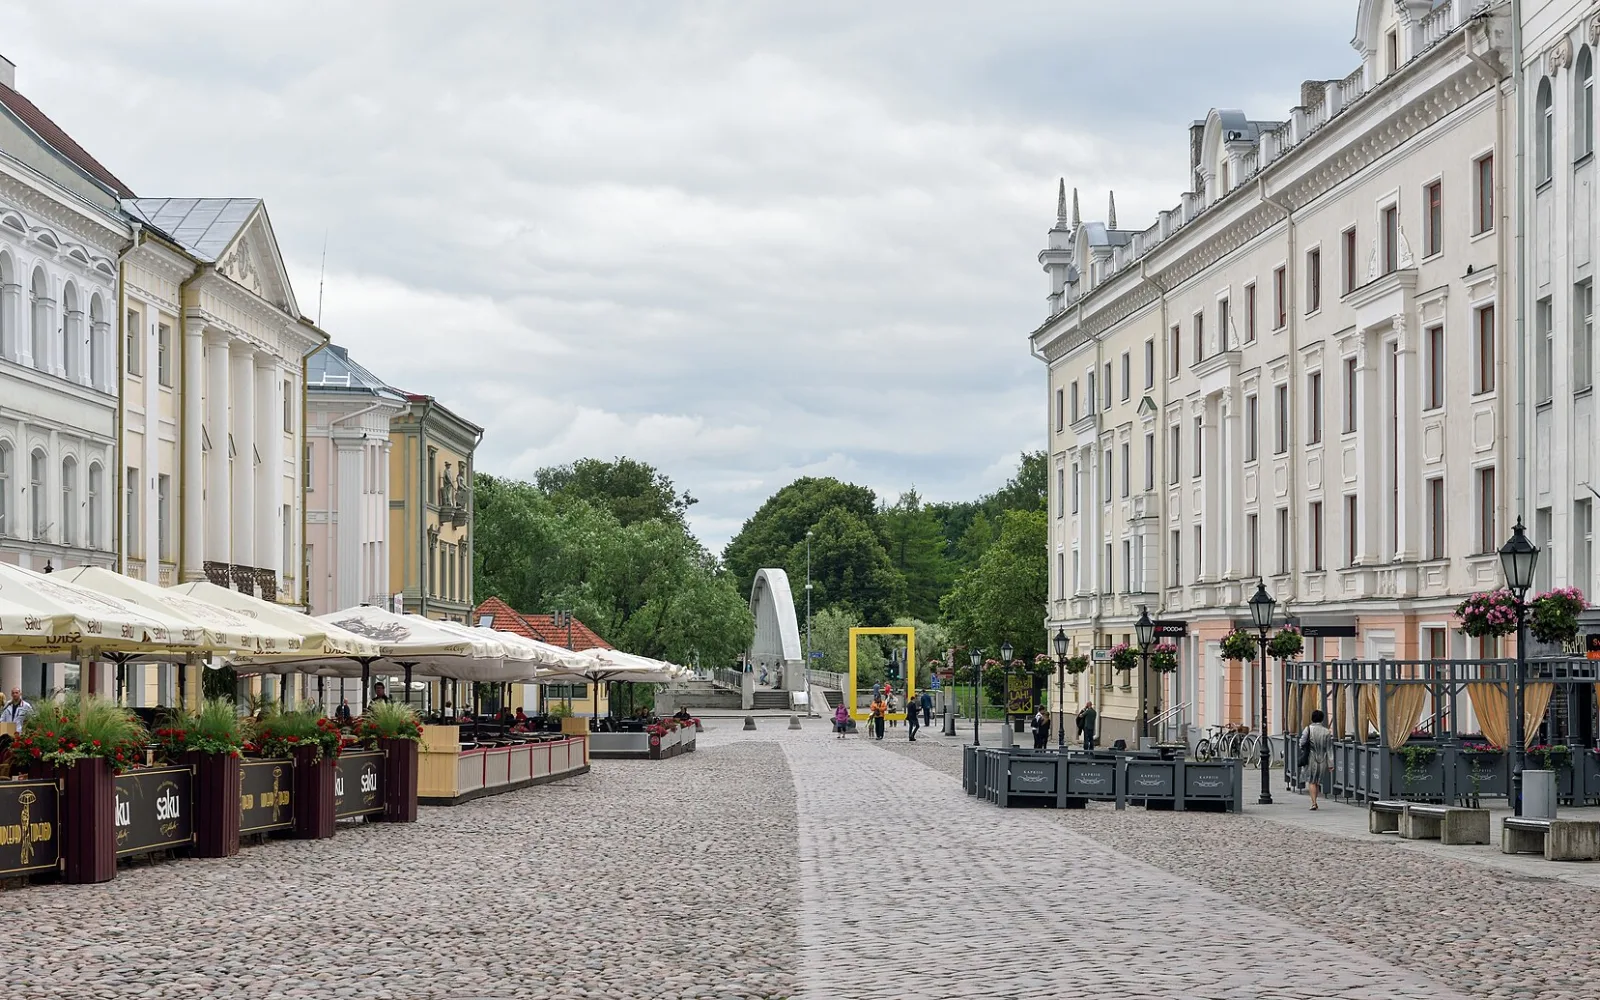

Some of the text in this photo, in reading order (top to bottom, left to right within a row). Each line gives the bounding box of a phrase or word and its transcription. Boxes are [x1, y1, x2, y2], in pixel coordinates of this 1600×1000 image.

[24, 614, 42, 631] saku
[361, 768, 377, 793] saku
[156, 788, 180, 821] saku
